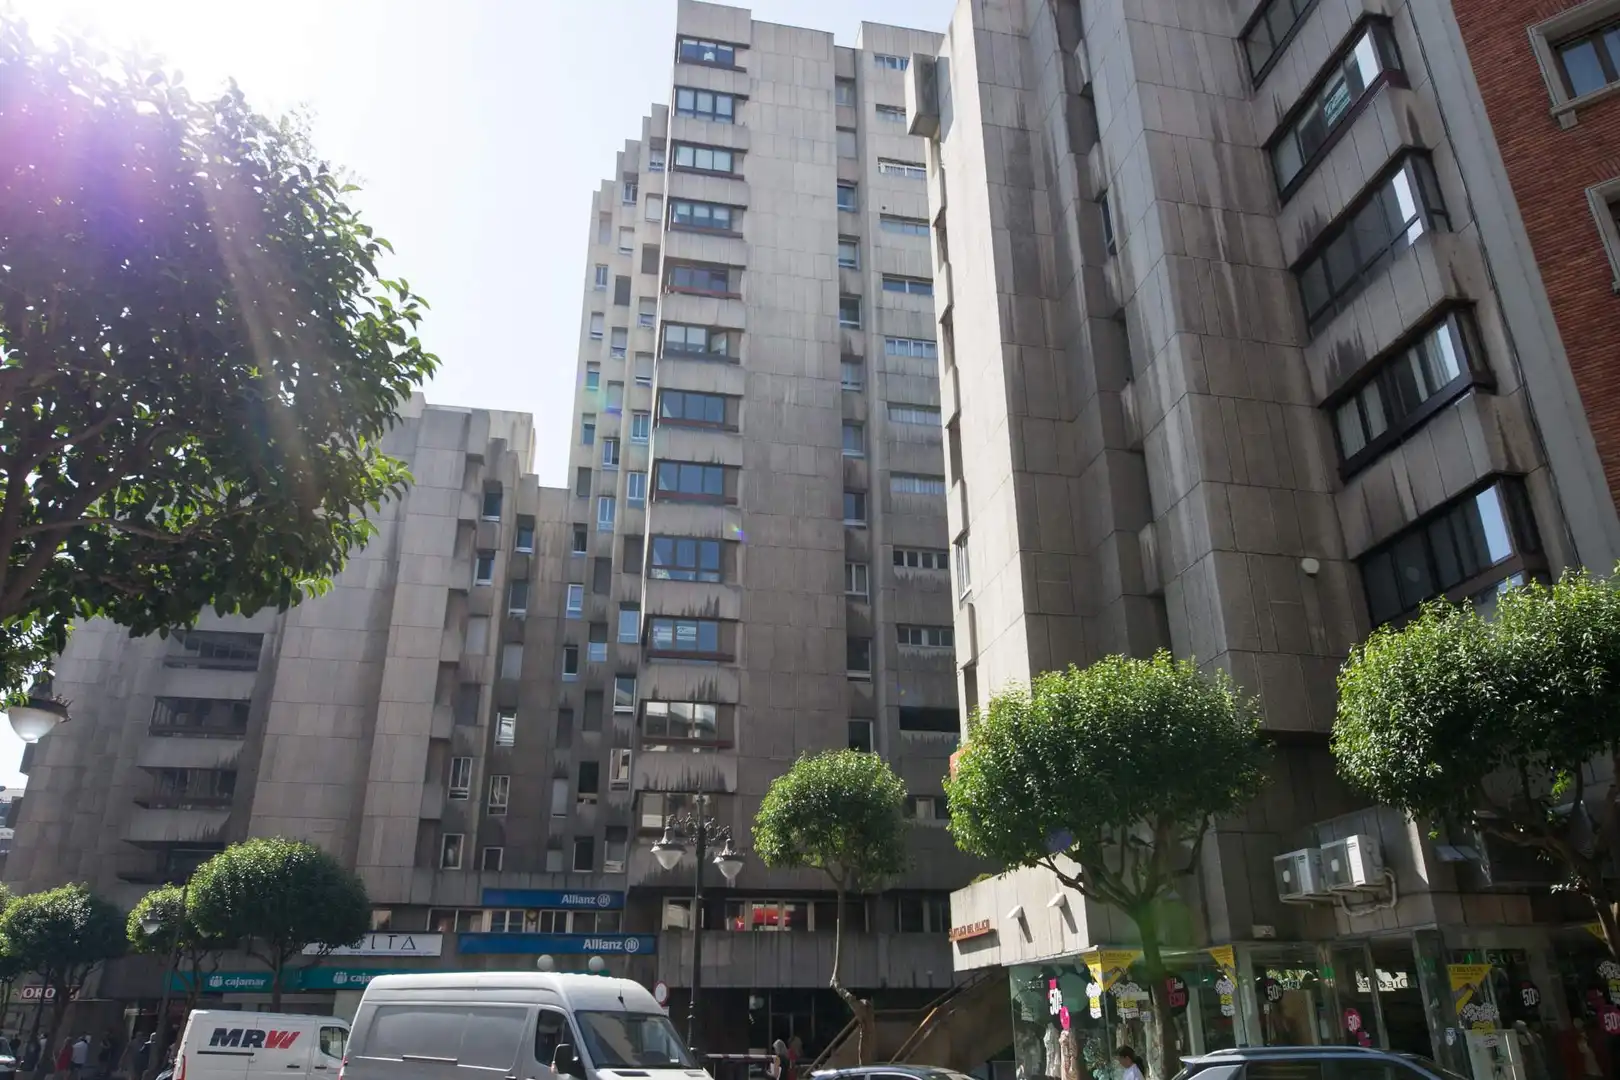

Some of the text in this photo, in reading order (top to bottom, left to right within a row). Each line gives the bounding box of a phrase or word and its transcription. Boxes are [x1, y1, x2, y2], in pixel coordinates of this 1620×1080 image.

[561, 894, 596, 905] Allianz
[583, 938, 623, 950] Allianz
[225, 977, 266, 988] cajamar
[209, 1028, 301, 1049] MRW
